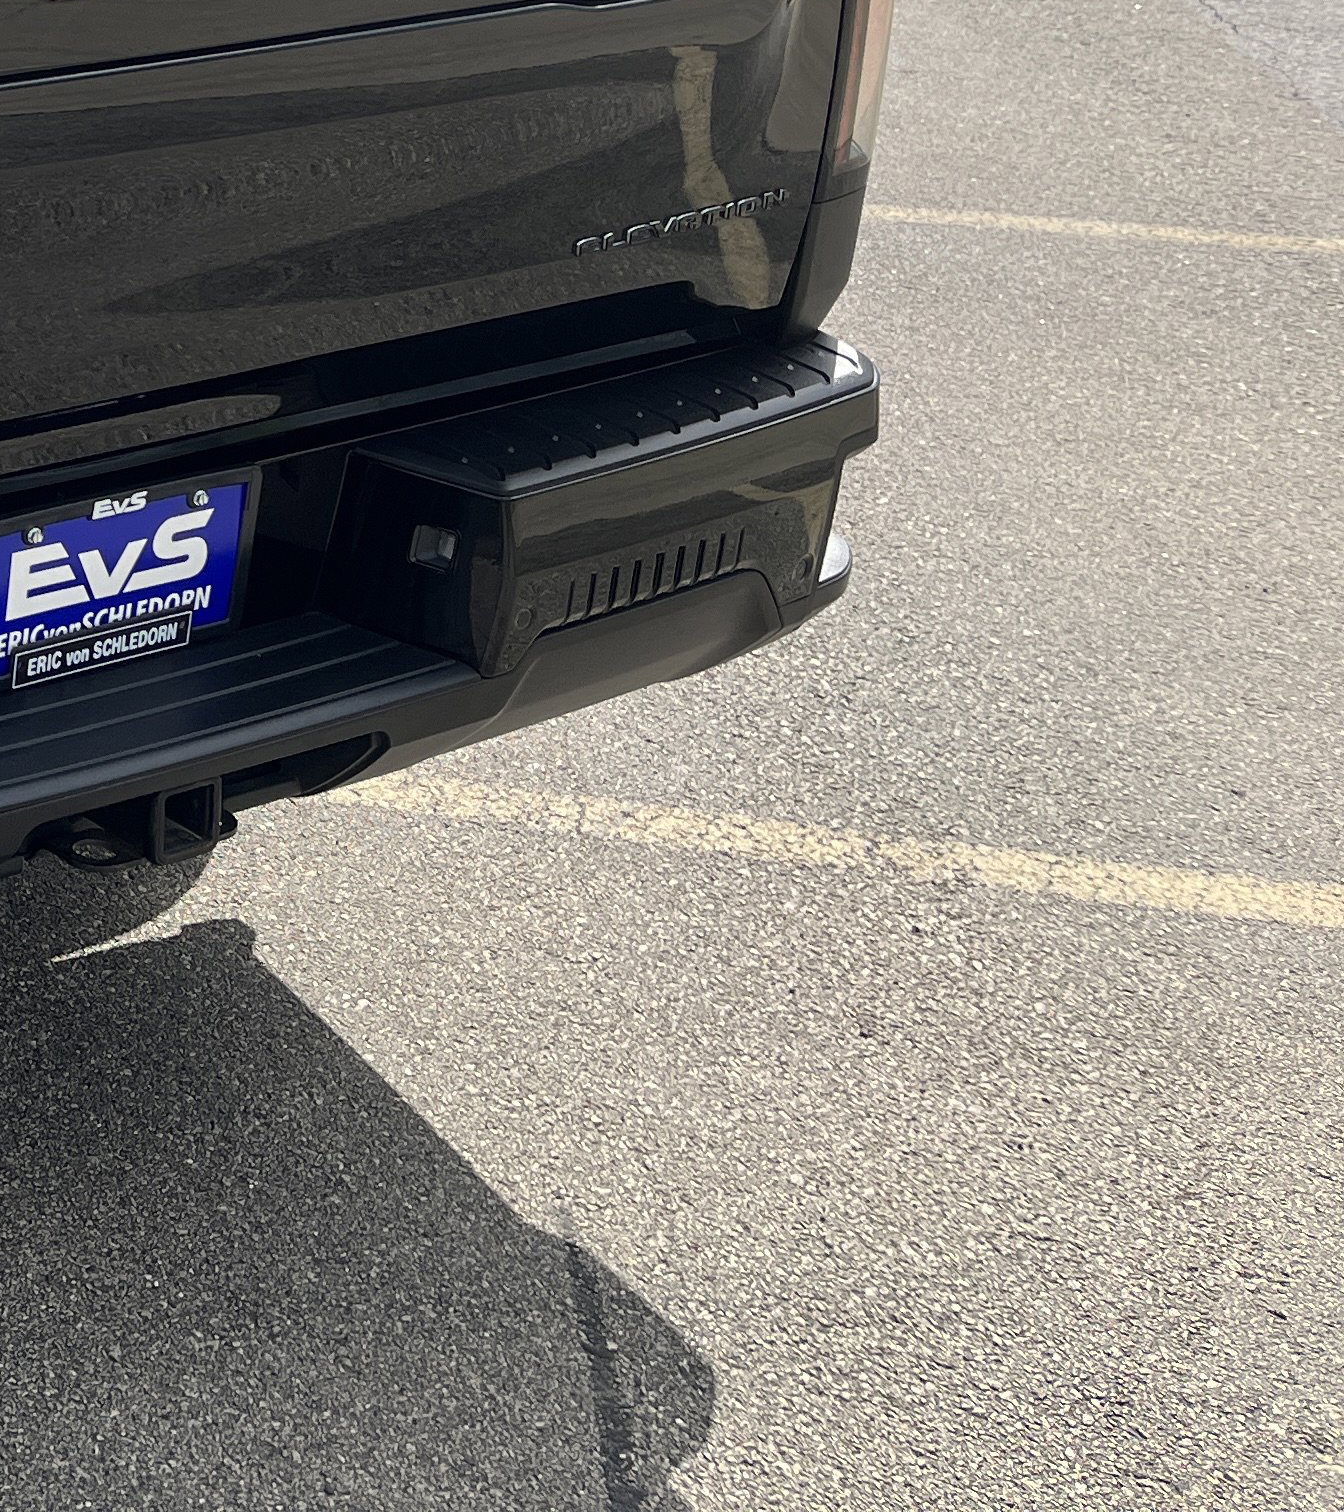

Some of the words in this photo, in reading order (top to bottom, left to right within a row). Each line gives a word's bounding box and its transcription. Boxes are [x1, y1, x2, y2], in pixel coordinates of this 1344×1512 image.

[575, 188, 788, 256] ELEVATION
[27, 651, 62, 676] ERIC
[66, 648, 90, 666] von
[93, 622, 178, 659] SCHLEDORN
